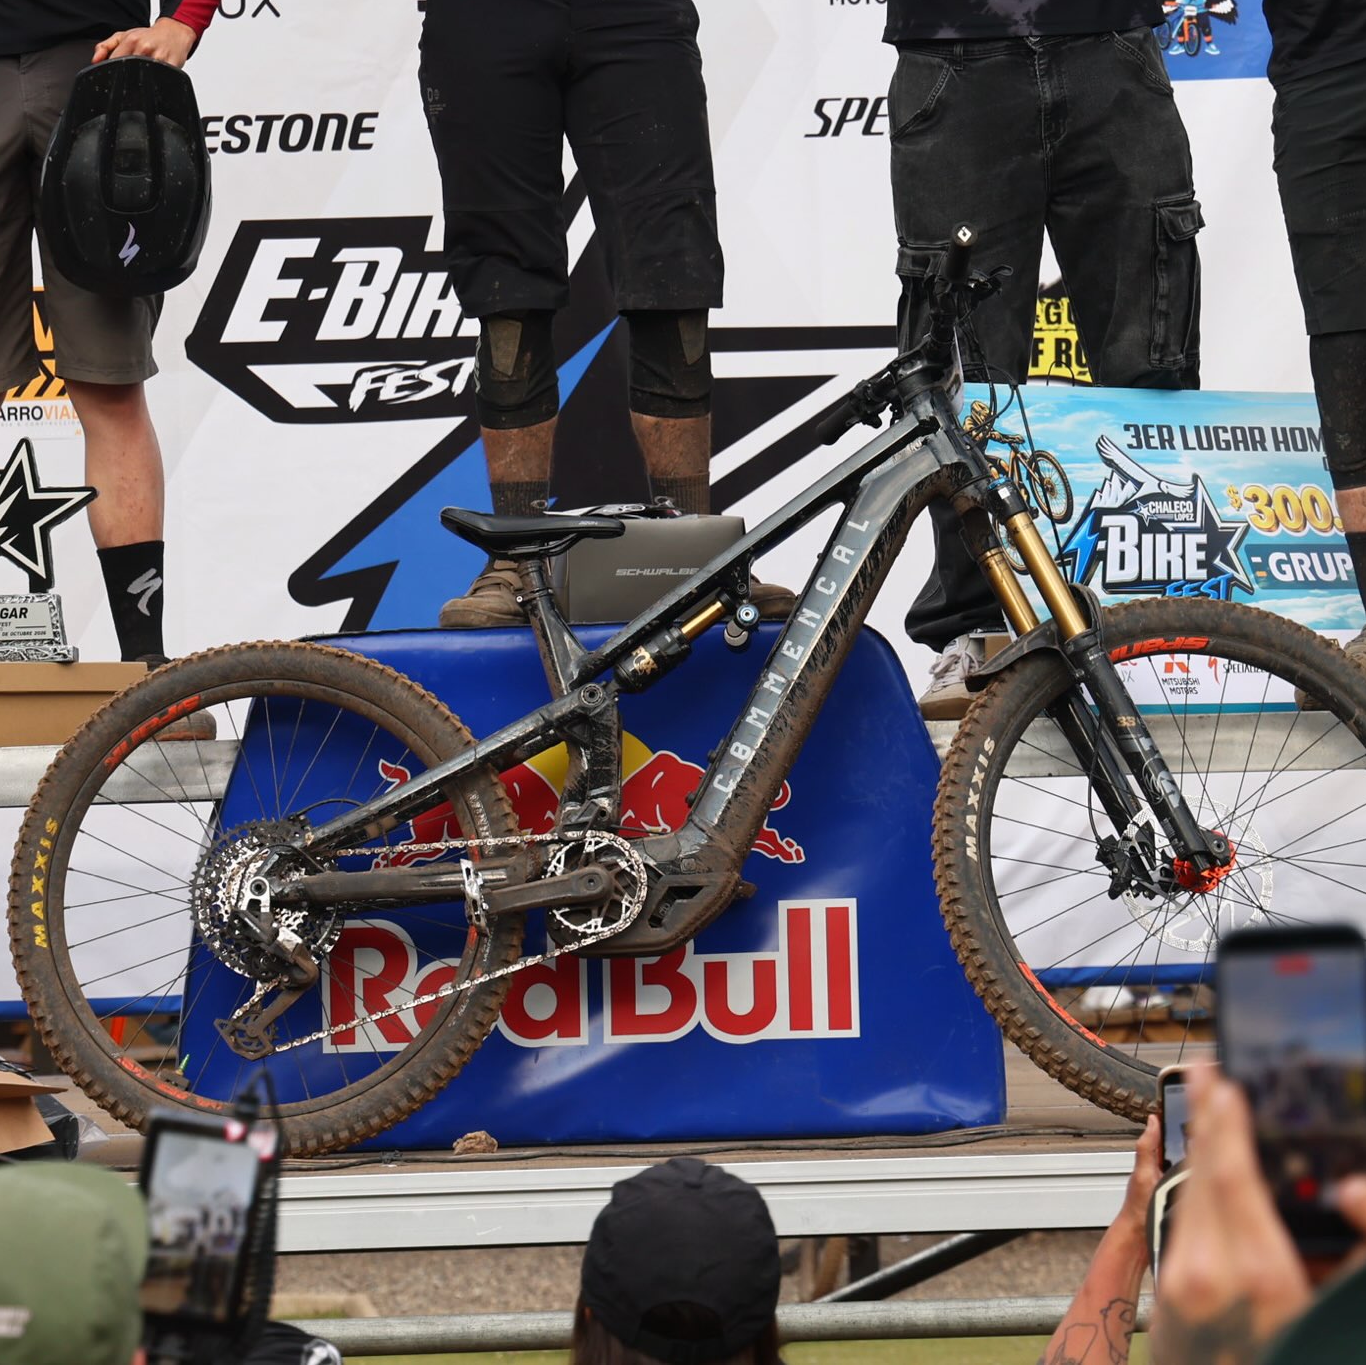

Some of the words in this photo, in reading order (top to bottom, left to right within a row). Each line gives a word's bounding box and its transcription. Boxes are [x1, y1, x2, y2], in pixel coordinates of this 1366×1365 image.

[205, 111, 379, 154] ESTONE
[219, 237, 481, 343] E-BIK
[349, 355, 475, 413] FEST
[1124, 423, 1176, 451] 3ER
[1185, 424, 1268, 453] LUGAR
[1148, 501, 1194, 514] CHALECO
[1174, 513, 1194, 521] LOPEZ
[615, 567, 700, 577] SCHWALBE
[1268, 551, 1353, 582] GRUP
[1162, 677, 1200, 686] MITSUBISHI
[1170, 687, 1198, 695] MOTORS
[965, 736, 996, 863] MAXXIS
[31, 816, 59, 950] MAXXIS
[607, 903, 855, 1040] Bull
